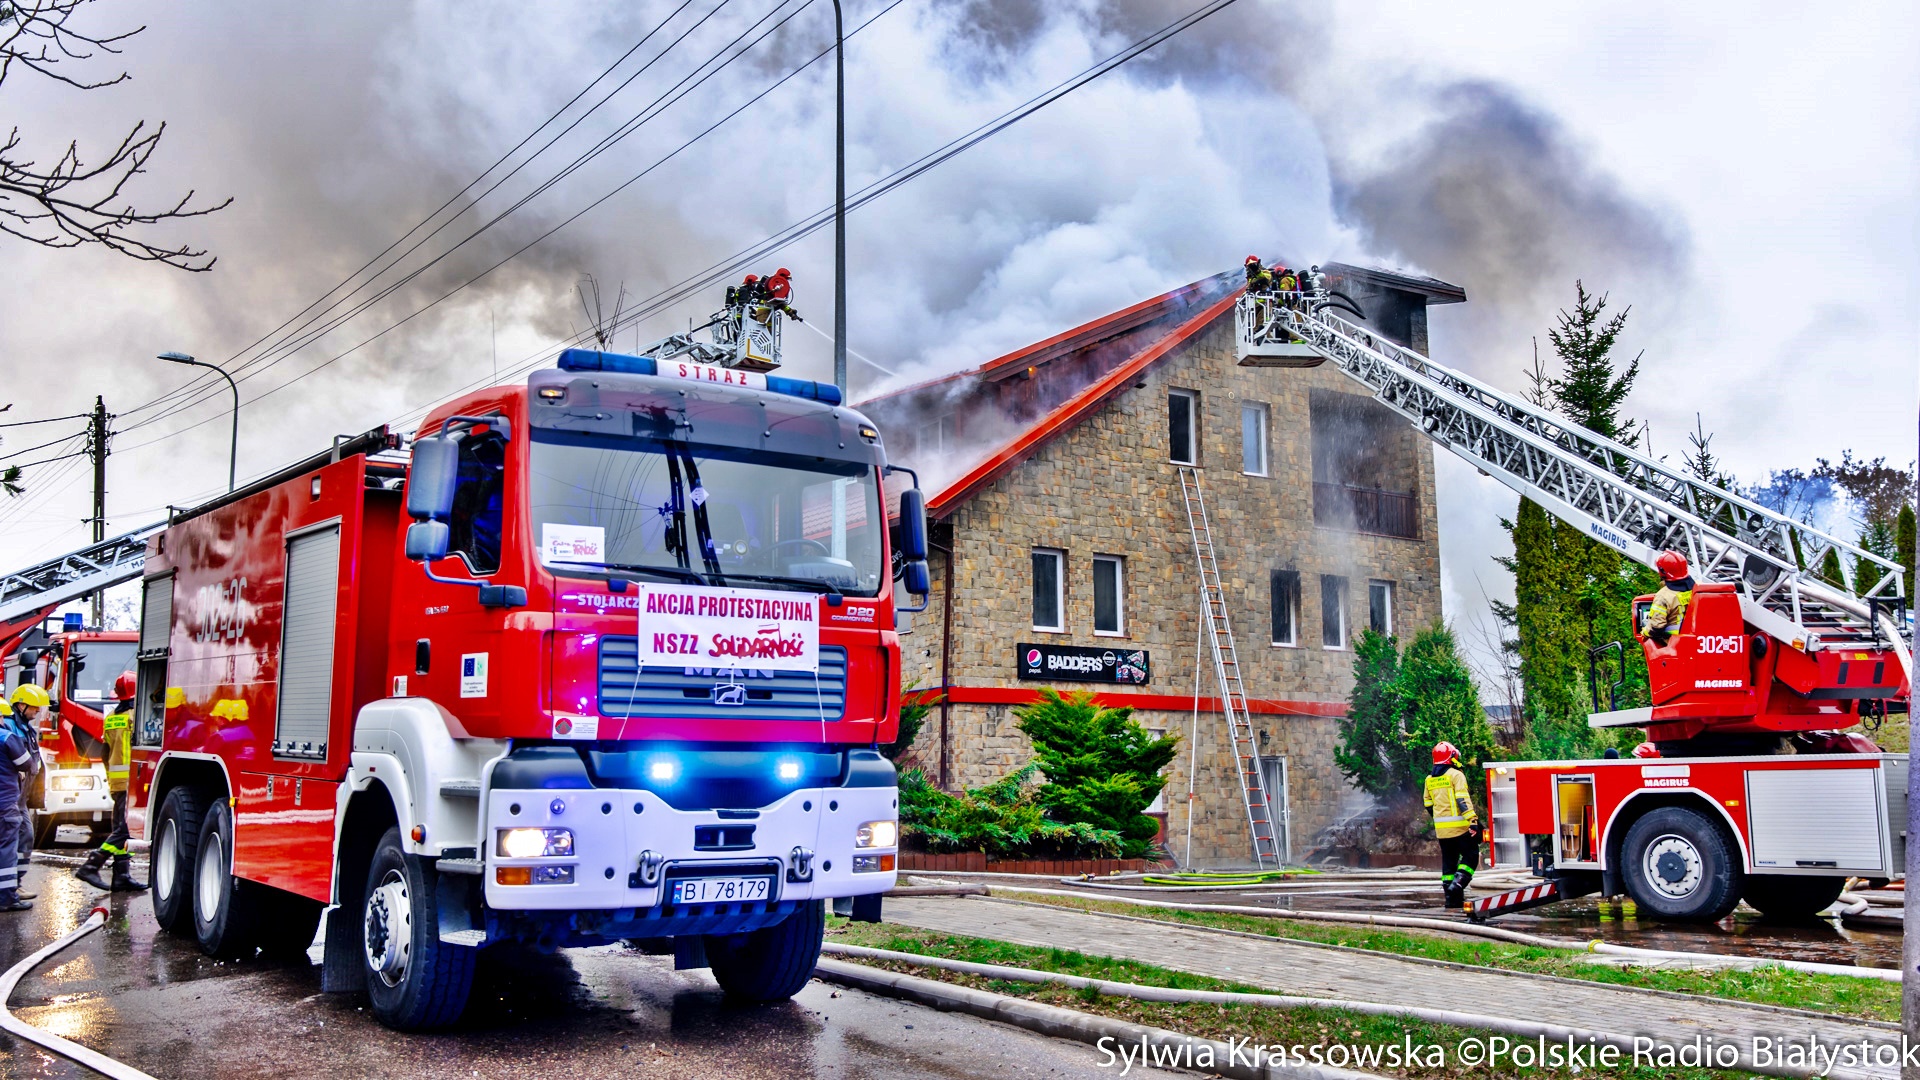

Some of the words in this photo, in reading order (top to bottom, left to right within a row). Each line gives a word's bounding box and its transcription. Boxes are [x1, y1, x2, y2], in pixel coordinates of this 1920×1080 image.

[1590, 522, 1628, 550] MAGIRUS
[646, 592, 695, 616] AKCJA
[698, 596, 813, 622] PROTESTACYJNA
[653, 632, 699, 655] NSZZ
[1047, 653, 1104, 673] BADDERS
[1695, 680, 1743, 688] MAGIRUS
[1644, 778, 1690, 787] MAGIRUS
[715, 880, 767, 899] 78179
